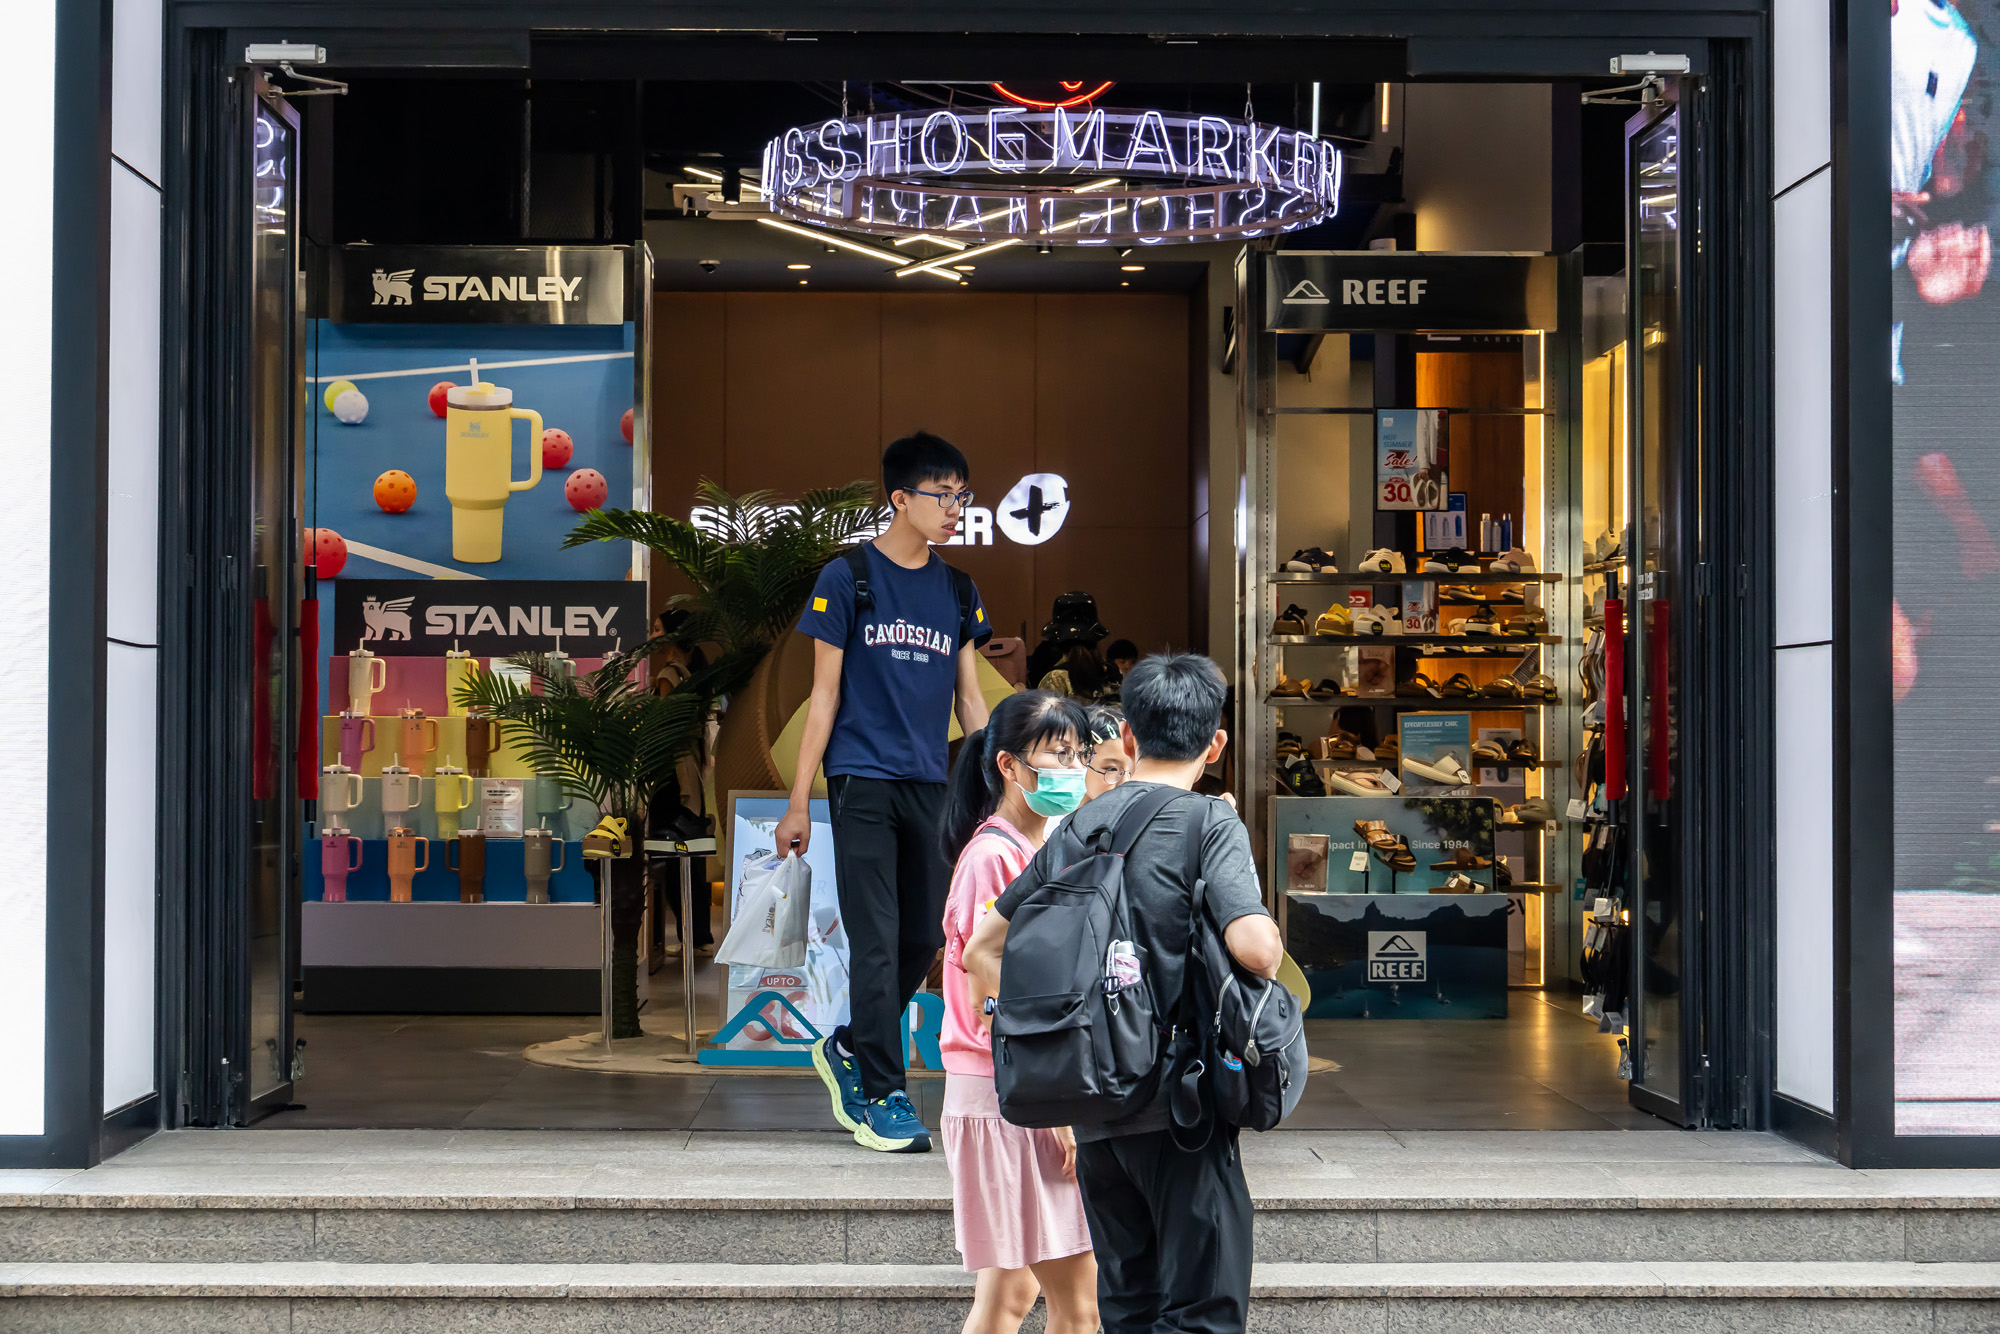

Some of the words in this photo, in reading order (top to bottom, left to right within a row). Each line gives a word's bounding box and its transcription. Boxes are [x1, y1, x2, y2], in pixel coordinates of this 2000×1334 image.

[423, 275, 583, 302] STANLEY
[1342, 279, 1428, 305] REEF
[1383, 452, 1418, 467] Sale!
[1383, 483, 1411, 502] 30
[425, 605, 620, 637] STANLEY
[864, 618, 952, 656] CAMÕESIAN
[891, 648, 911, 660] SINCE
[1412, 840, 1441, 850] Since
[1442, 840, 1470, 850] 1984
[1372, 962, 1423, 978] REEF
[766, 977, 780, 986] UP
[781, 977, 795, 986] TO
